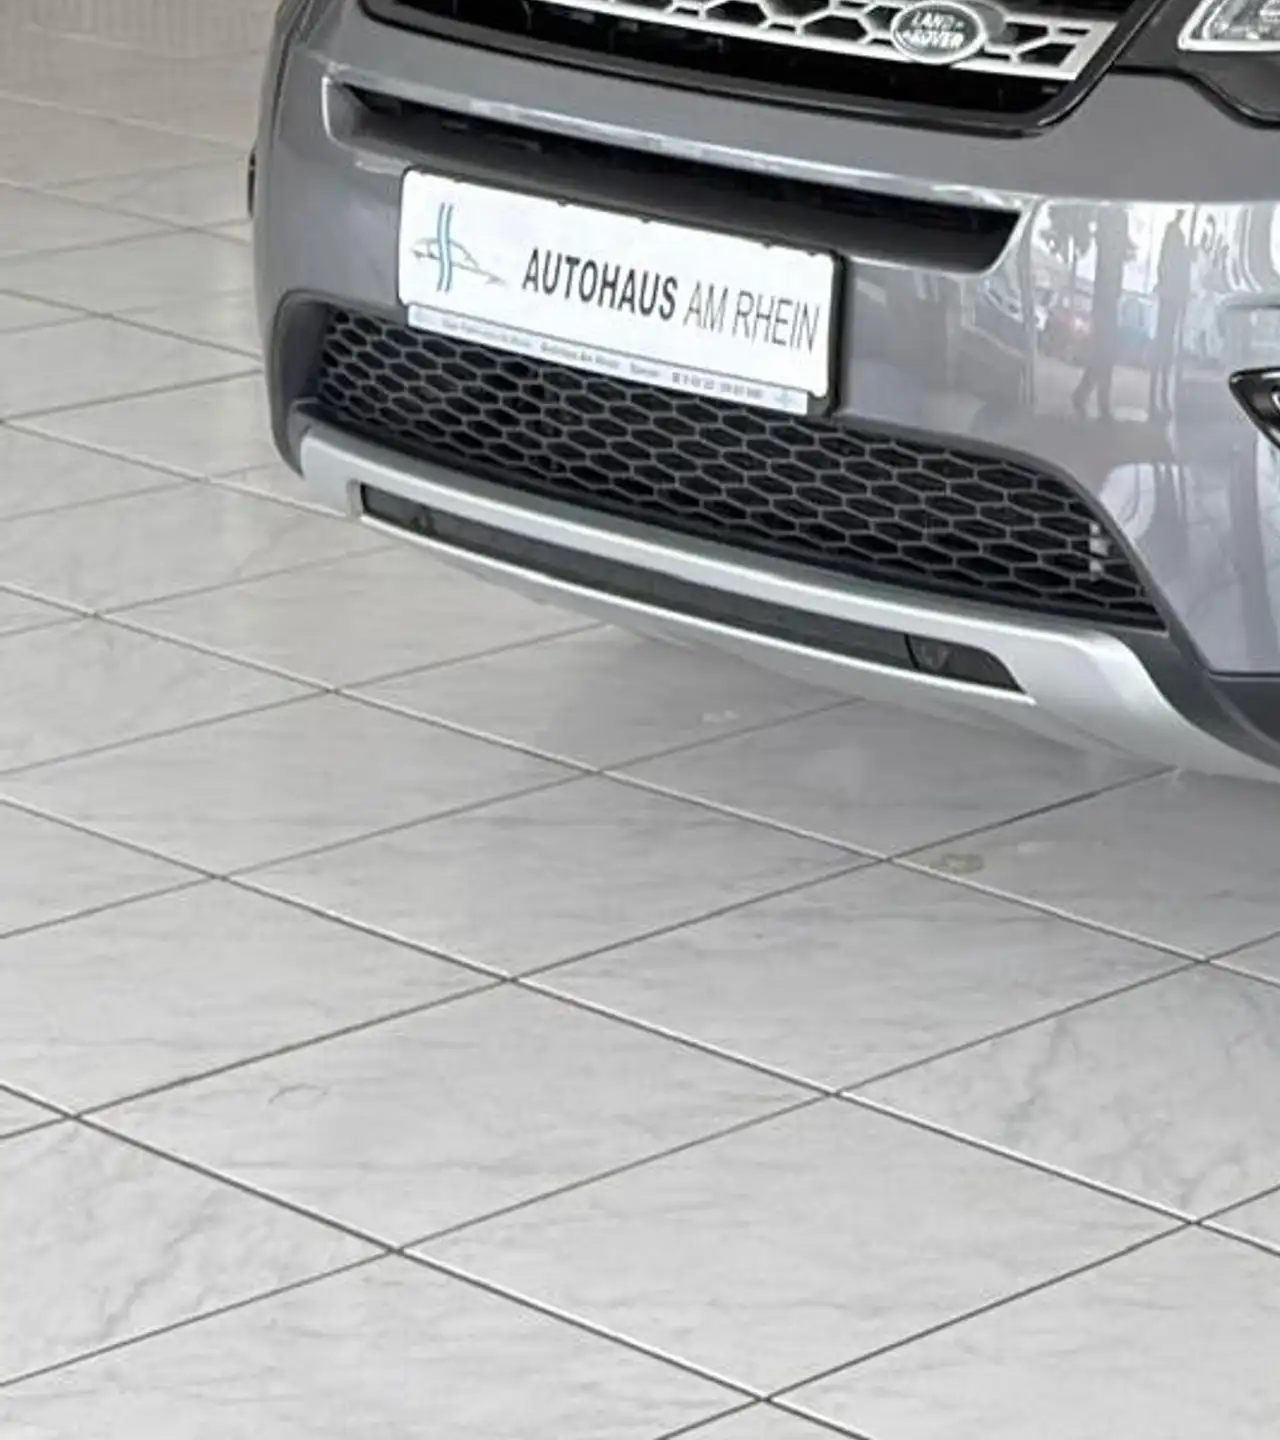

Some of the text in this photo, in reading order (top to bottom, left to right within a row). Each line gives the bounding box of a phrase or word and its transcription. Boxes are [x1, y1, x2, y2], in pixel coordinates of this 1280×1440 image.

[911, 11, 955, 30] LAND
[910, 28, 965, 49] ROVER
[521, 247, 824, 355] AUTOHAUS AM RHEIN
